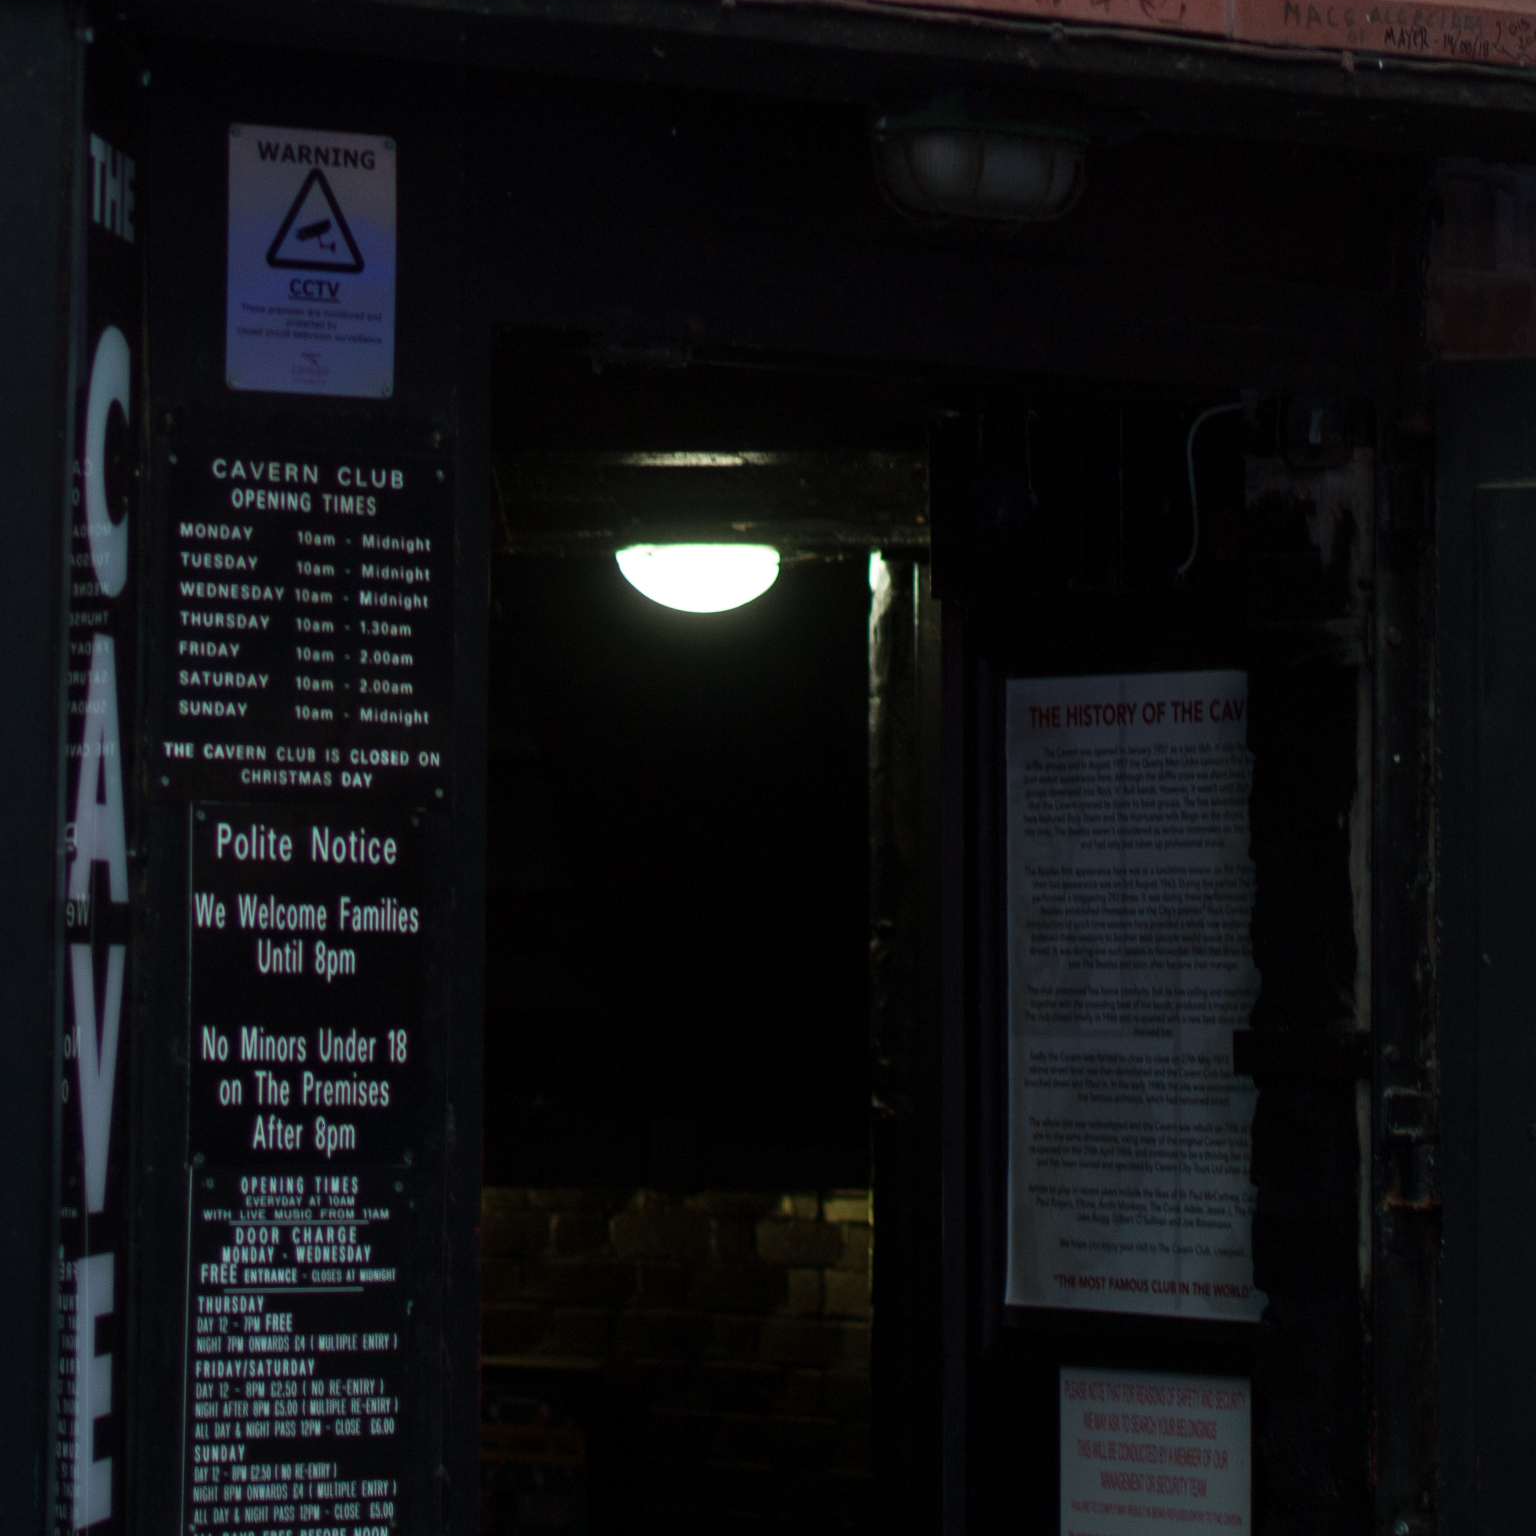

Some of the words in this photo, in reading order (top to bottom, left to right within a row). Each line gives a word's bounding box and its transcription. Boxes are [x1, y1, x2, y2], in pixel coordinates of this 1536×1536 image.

[258, 140, 376, 169] WARNING
[290, 279, 340, 298] CCTV
[213, 459, 318, 484] CAVERN
[337, 466, 403, 489] CLUB
[232, 488, 311, 512] OPENING
[323, 493, 376, 515] TIMES
[180, 523, 253, 540] MONDAY
[298, 531, 335, 546] 10am
[363, 534, 431, 553] Midnight
[181, 552, 257, 571] TUESDAY
[297, 561, 334, 576] 10am
[362, 564, 430, 583] Midnight
[180, 582, 284, 600] WEDNESDAY
[295, 588, 332, 603] 10am
[360, 591, 428, 610] Midnight
[180, 611, 270, 630] THURSDAY
[297, 618, 334, 633] 10am
[360, 621, 411, 637] 1.30am
[179, 641, 239, 657] FRIDAY
[296, 647, 334, 662] 10am
[360, 650, 413, 665] 2.00am
[179, 670, 268, 688] SATURDAY
[296, 676, 334, 691] 10am
[360, 679, 413, 694] 2.00am
[179, 700, 247, 716] SUNDAY
[295, 706, 333, 720] 10am
[360, 708, 429, 727] Midnight
[1029, 706, 1060, 729] THE
[1066, 703, 1137, 726] HISTORY
[1142, 701, 1165, 724] OF
[1171, 700, 1202, 724] THE
[164, 742, 193, 758] THE
[204, 744, 266, 760] CAVERN
[277, 747, 315, 762] CLUB
[325, 749, 340, 763] IS
[350, 749, 409, 765] CLOSED
[419, 752, 440, 766] ON
[241, 769, 332, 786] CHRISTMAS
[342, 772, 372, 787] DAY
[216, 823, 292, 861] Polite
[312, 826, 396, 864] Notice
[195, 893, 226, 929] We
[238, 894, 326, 931] Welcome
[340, 896, 418, 933] Families
[258, 938, 302, 974] Until
[316, 940, 355, 983] 8pm
[203, 1026, 228, 1062] No
[241, 1026, 306, 1062] Minors
[320, 1028, 376, 1062] Under
[388, 1029, 407, 1062] 18
[220, 1079, 242, 1106] on
[255, 1070, 289, 1106] The
[303, 1071, 389, 1106] Premises
[253, 1115, 302, 1150] After
[316, 1116, 355, 1158] 8pm
[241, 1176, 304, 1194] OPENING
[315, 1177, 358, 1194] TIMES
[246, 1196, 302, 1207] EVERYDAY
[309, 1196, 321, 1206] AT
[329, 1196, 354, 1206] 10AM
[203, 1209, 231, 1220] WITH
[240, 1209, 264, 1220] LIVE
[275, 1209, 312, 1220] MUSIC
[321, 1209, 354, 1219] FROM
[363, 1208, 389, 1219] 11AM
[236, 1227, 279, 1244] DOOR
[292, 1227, 356, 1244] CHARGE
[222, 1245, 274, 1263] MONDAY
[296, 1245, 371, 1263] WEDNESDAY
[201, 1264, 237, 1284] FREE
[244, 1268, 297, 1284] ENTRANCE
[1079, 1276, 1105, 1289] MOST
[1109, 1277, 1149, 1292] FAMOUS
[1152, 1280, 1176, 1293] CLUB
[198, 1296, 264, 1313] THURSDAY
[198, 1317, 213, 1333] DAY
[266, 1314, 292, 1332] FREE
[196, 1359, 314, 1378] FRIDAY/SATURDAY
[195, 1445, 245, 1462] SUNDAY
